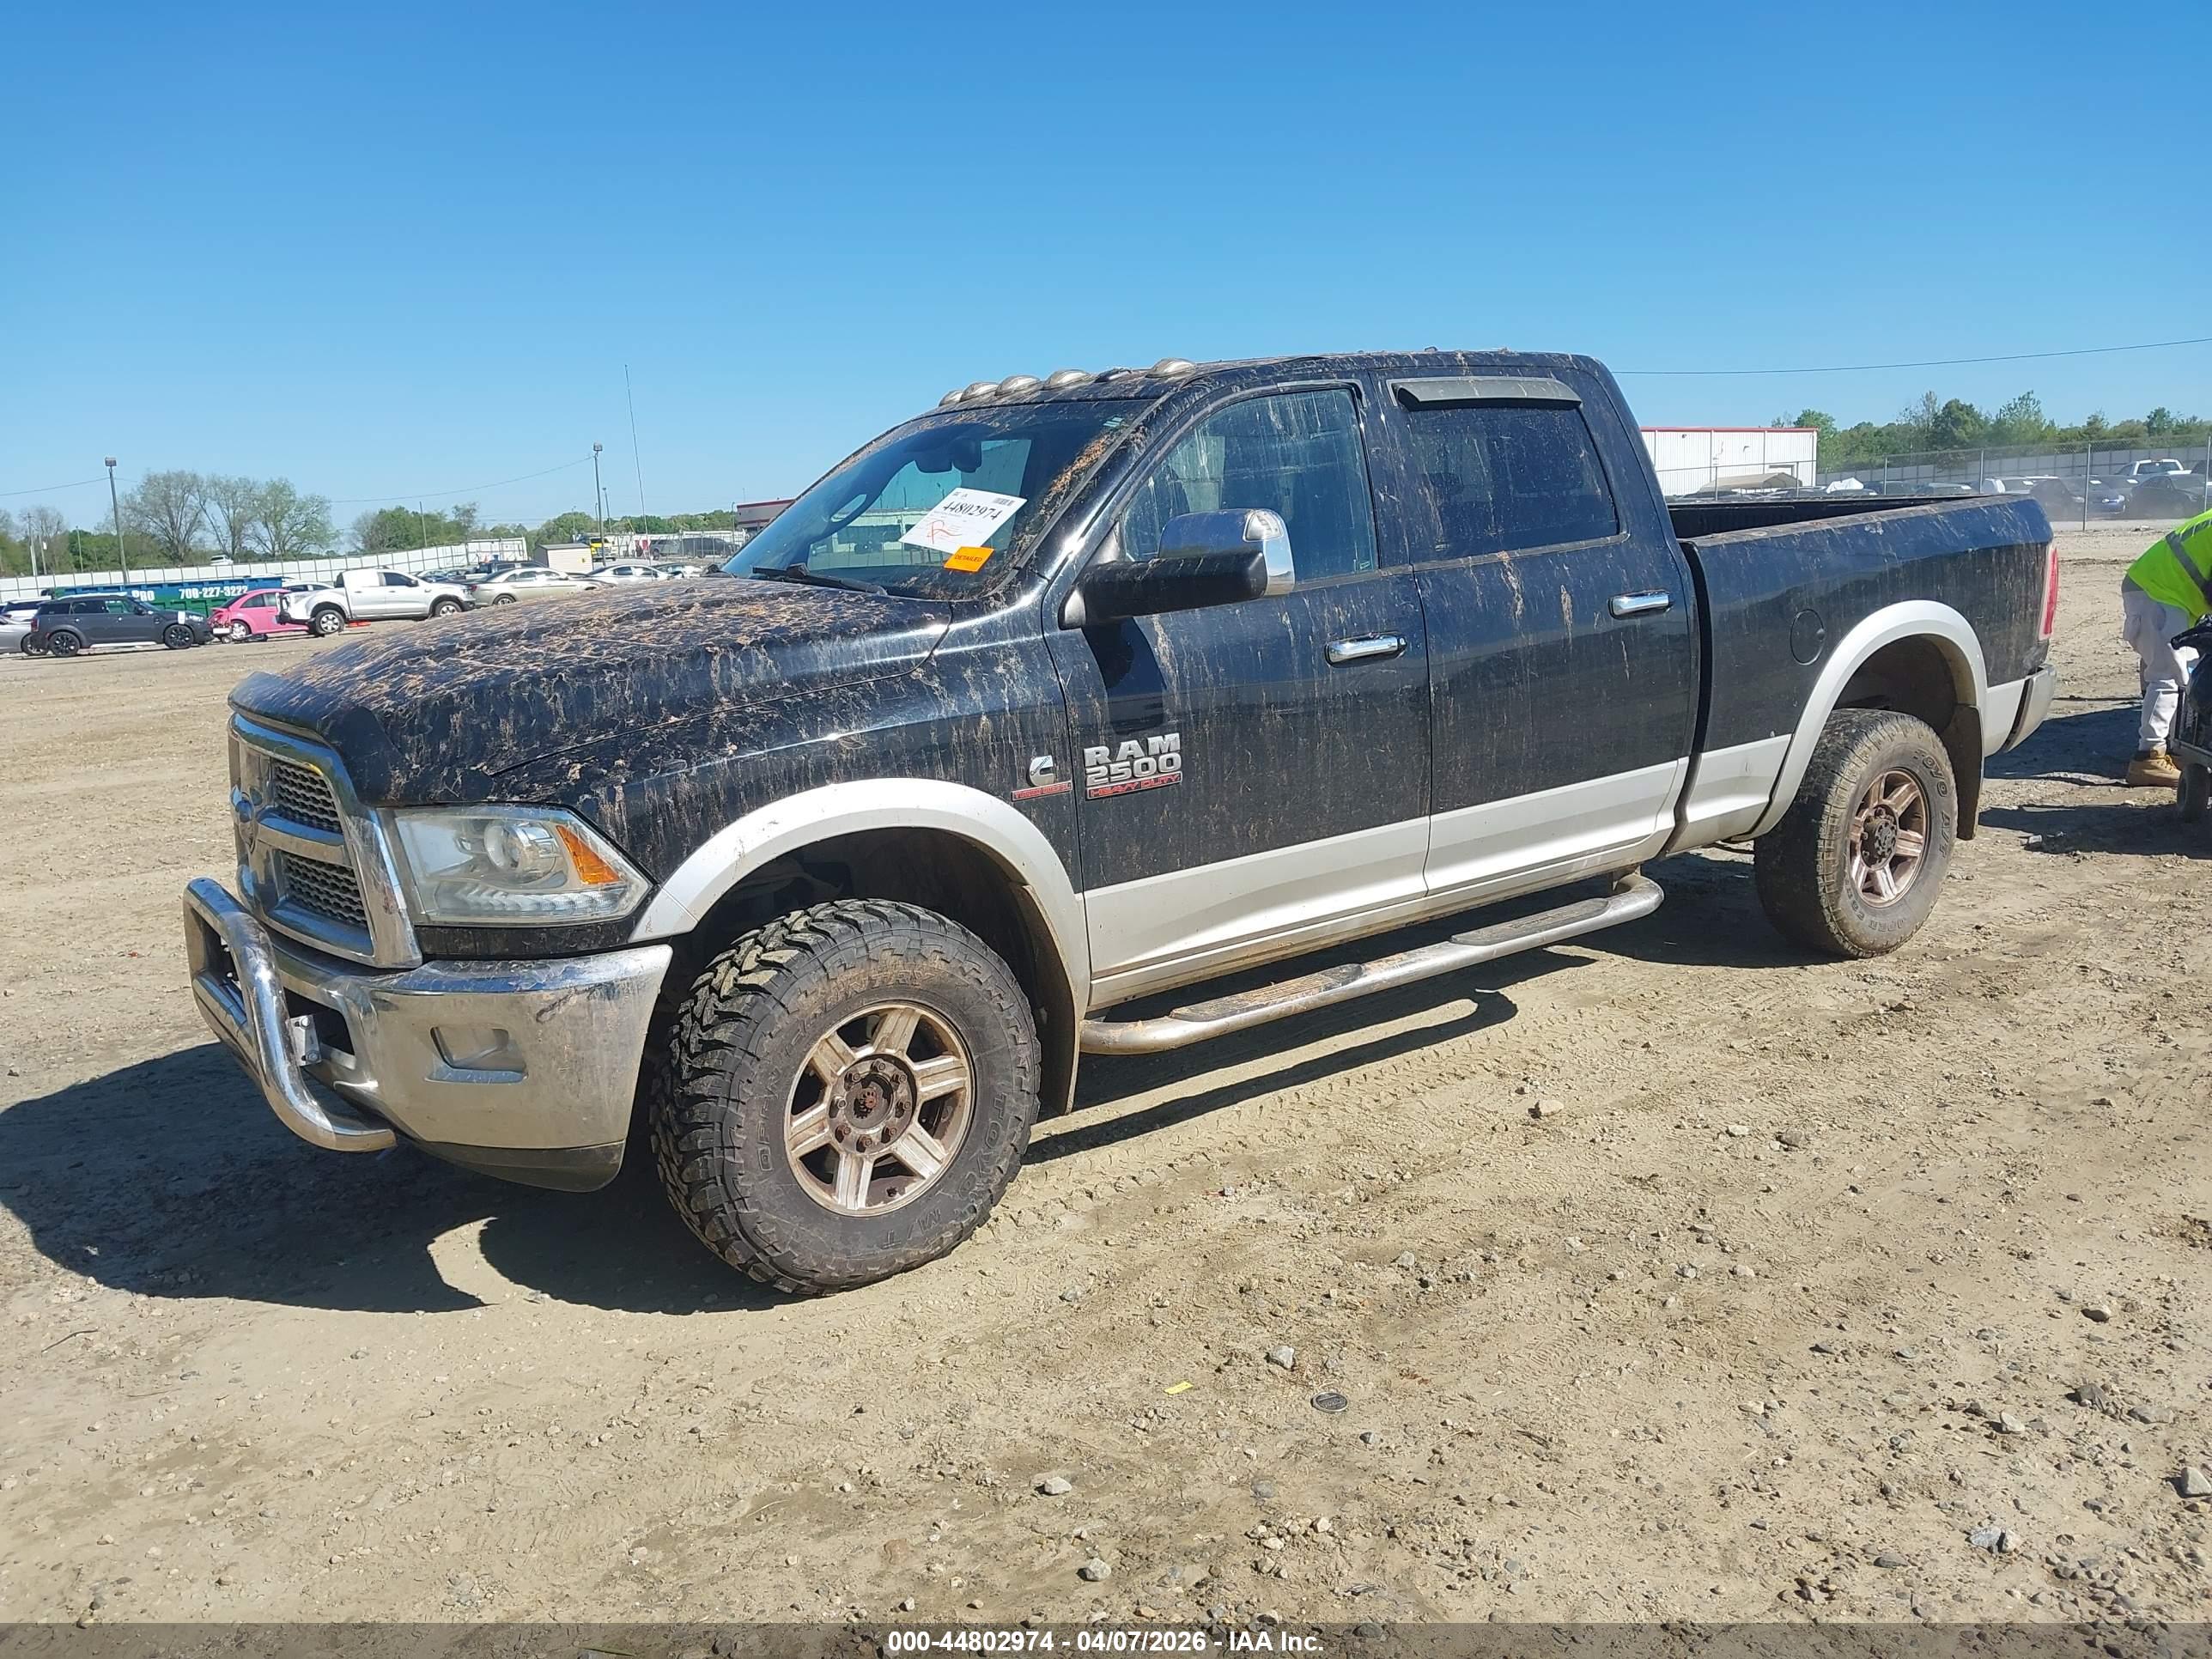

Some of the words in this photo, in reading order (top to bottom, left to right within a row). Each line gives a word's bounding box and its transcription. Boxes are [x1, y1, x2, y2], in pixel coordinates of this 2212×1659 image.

[943, 501, 1003, 521] 44802974
[955, 555, 983, 563] DETAILED
[1084, 732, 1182, 768] RAM
[1085, 751, 1182, 787] 2500
[1913, 747, 1948, 798] TOYO
[958, 1091, 1008, 1201] TOYO
